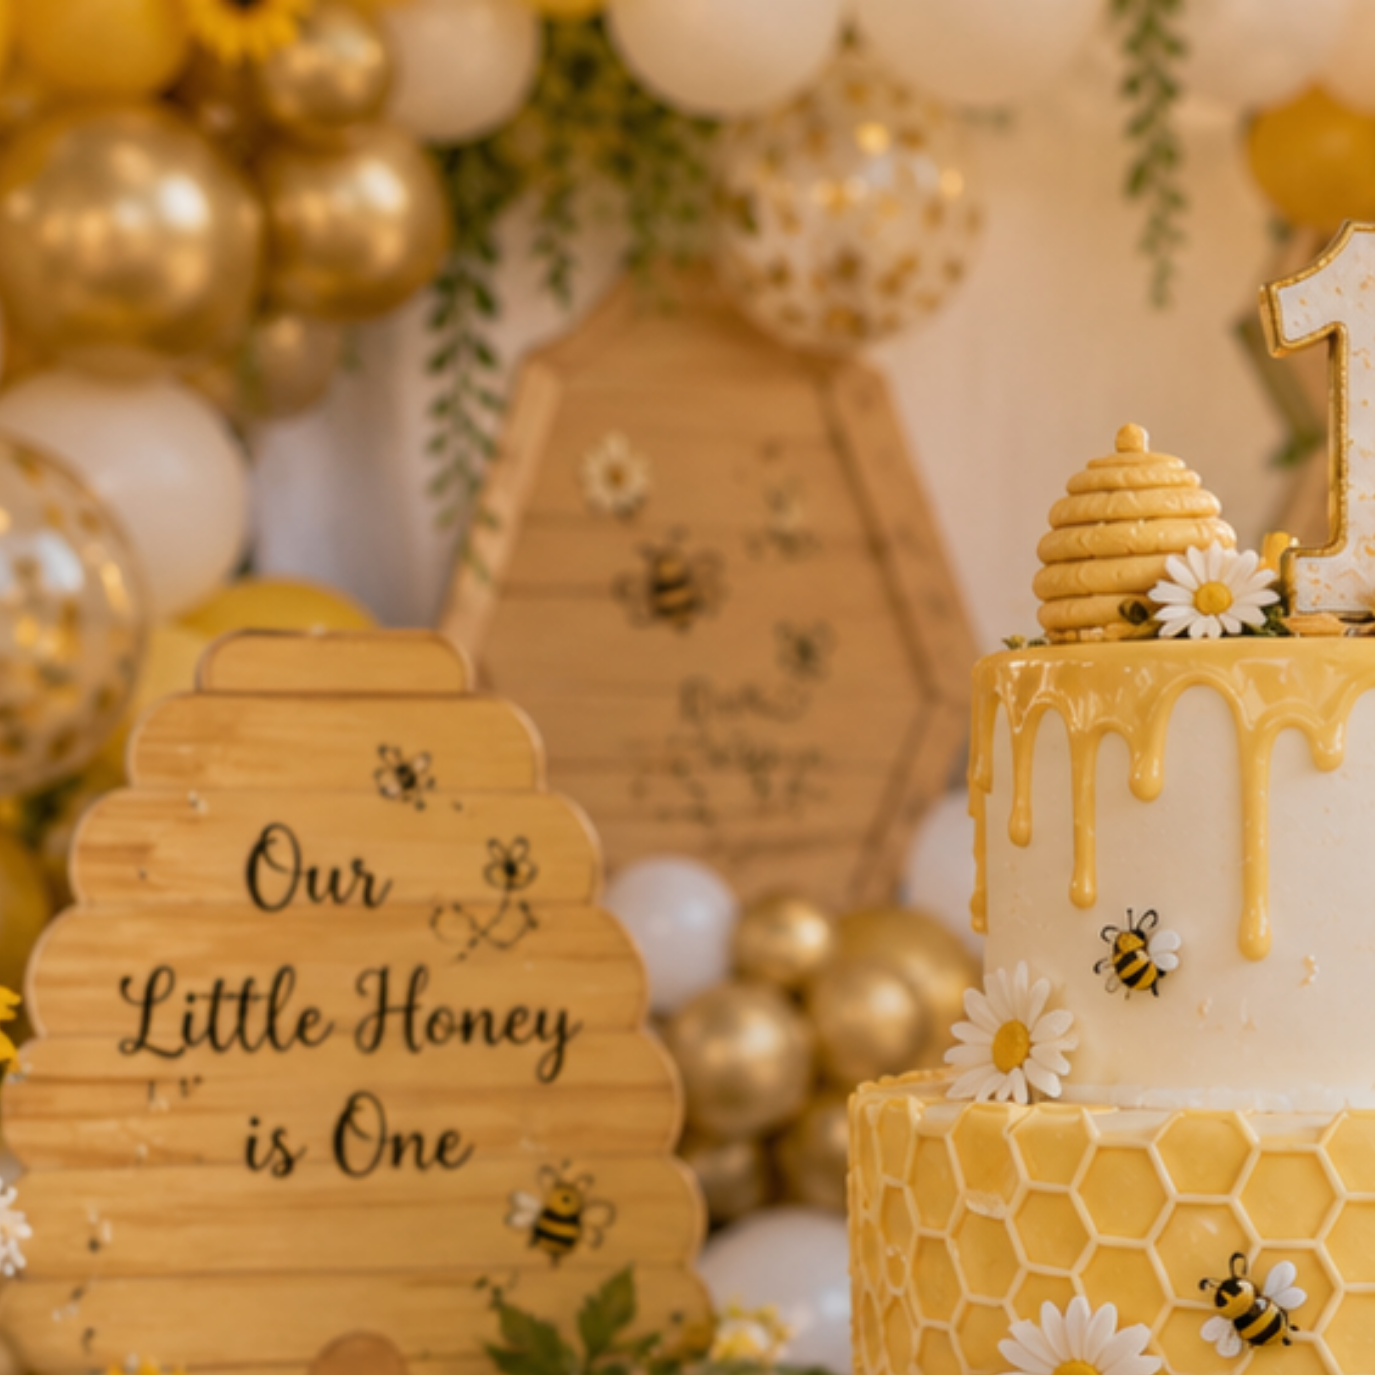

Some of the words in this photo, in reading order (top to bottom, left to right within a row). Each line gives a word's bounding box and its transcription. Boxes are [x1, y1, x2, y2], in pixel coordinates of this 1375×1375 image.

[244, 822, 393, 912] Our
[117, 965, 337, 1060] Little
[353, 963, 583, 1084] Honey
[244, 1115, 308, 1179] is
[331, 1090, 475, 1178] One
